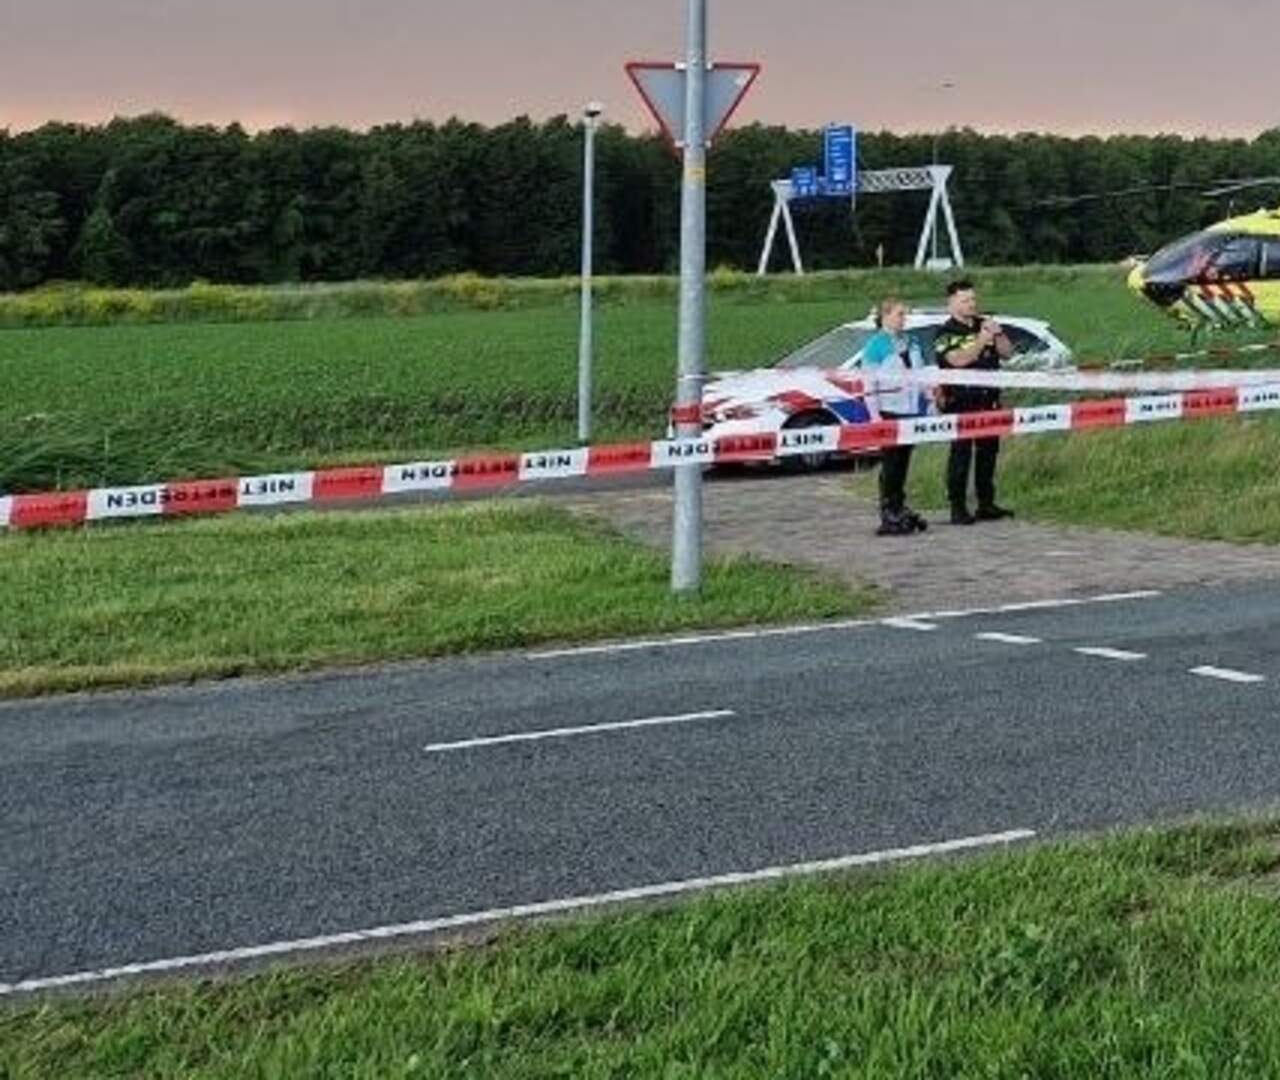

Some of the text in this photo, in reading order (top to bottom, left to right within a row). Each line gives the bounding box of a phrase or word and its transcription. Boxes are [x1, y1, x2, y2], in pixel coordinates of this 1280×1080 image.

[780, 432, 824, 447] NIET
[525, 455, 572, 469] NIET
[107, 477, 296, 508] NIET BETREDEN
